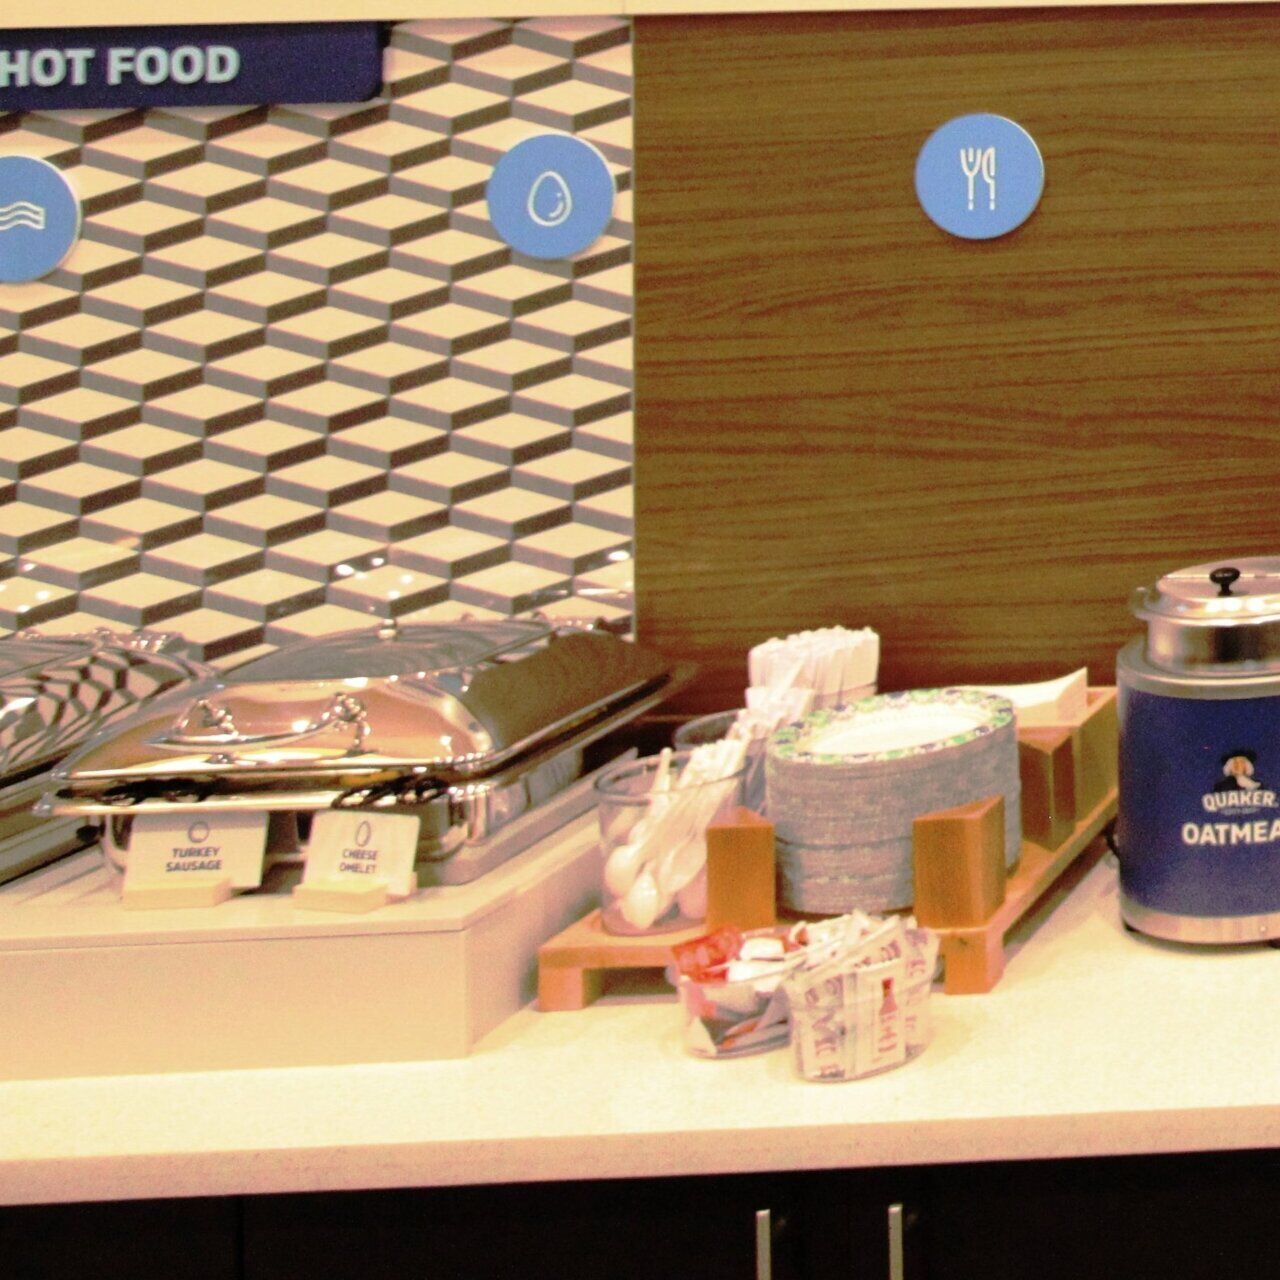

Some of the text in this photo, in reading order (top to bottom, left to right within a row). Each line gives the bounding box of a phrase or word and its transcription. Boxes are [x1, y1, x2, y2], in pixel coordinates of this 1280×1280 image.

[0, 45, 241, 87] HOT FOOD
[1201, 789, 1276, 813] QUAKER
[172, 846, 221, 858] TURKEY
[342, 848, 378, 860] CHEESE
[165, 859, 222, 872] SAUSAGE
